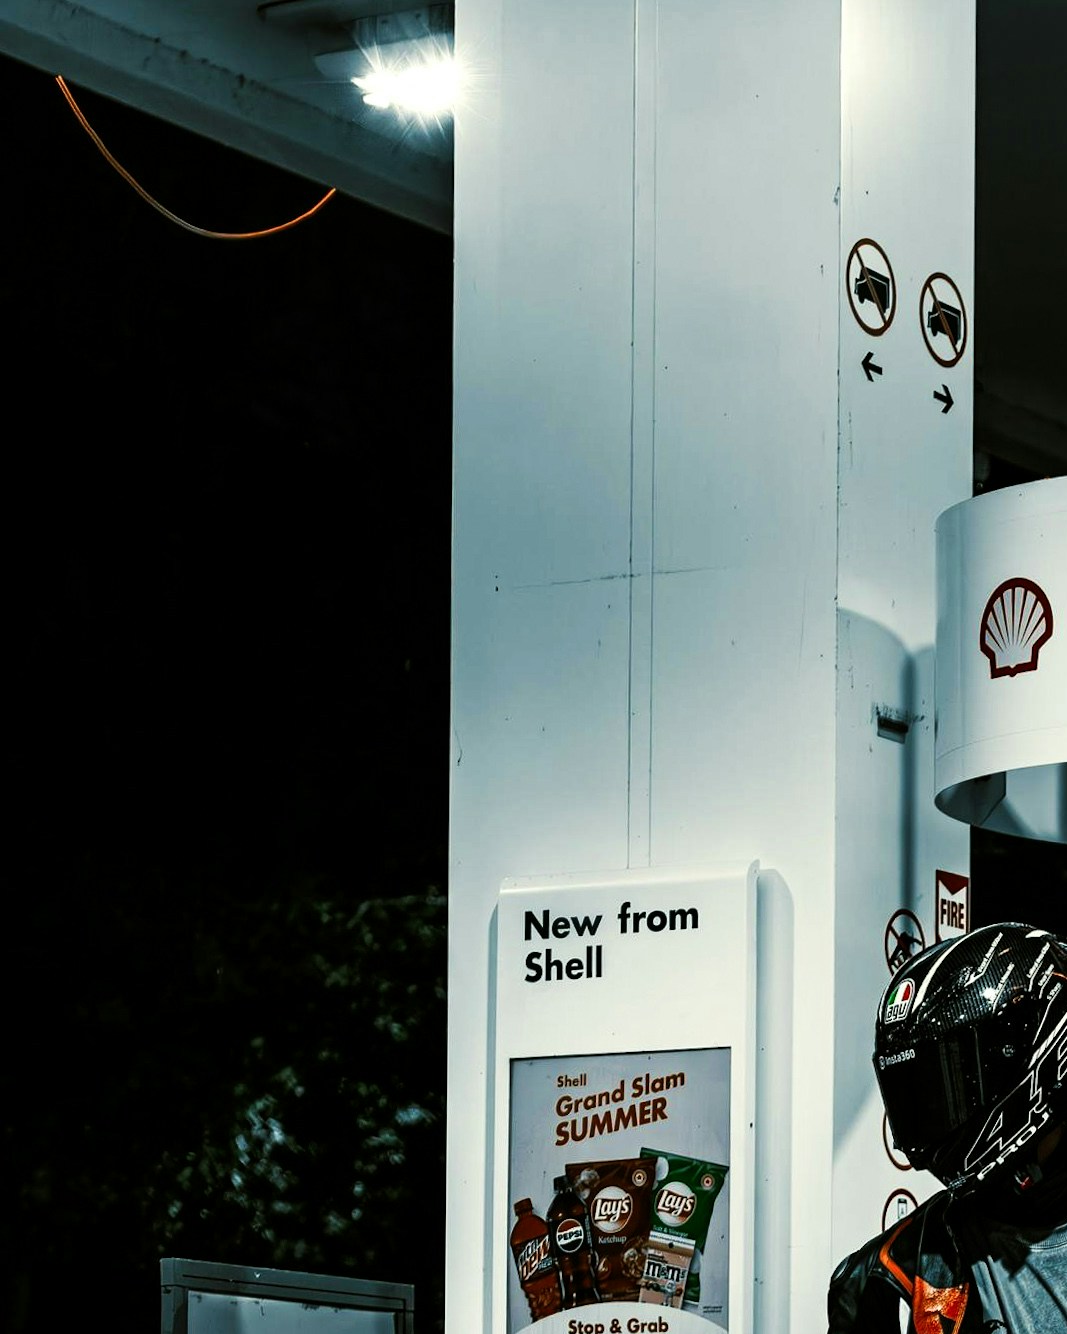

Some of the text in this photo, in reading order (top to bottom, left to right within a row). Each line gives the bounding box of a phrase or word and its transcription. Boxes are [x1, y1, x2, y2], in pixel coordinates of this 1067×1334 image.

[524, 902, 699, 942] New from
[940, 898, 965, 930] FIRE
[524, 945, 603, 983] Shell
[556, 1072, 686, 1118] Grand Slam
[557, 1073, 587, 1088] Shell
[555, 1096, 669, 1147] SUMMER
[595, 1192, 630, 1221] Lay's
[657, 1189, 695, 1216] Lay's
[557, 1227, 583, 1241] PEPSI
[598, 1234, 627, 1245] Ketchup
[609, 1318, 622, 1334] &
[627, 1316, 669, 1334] Grab
